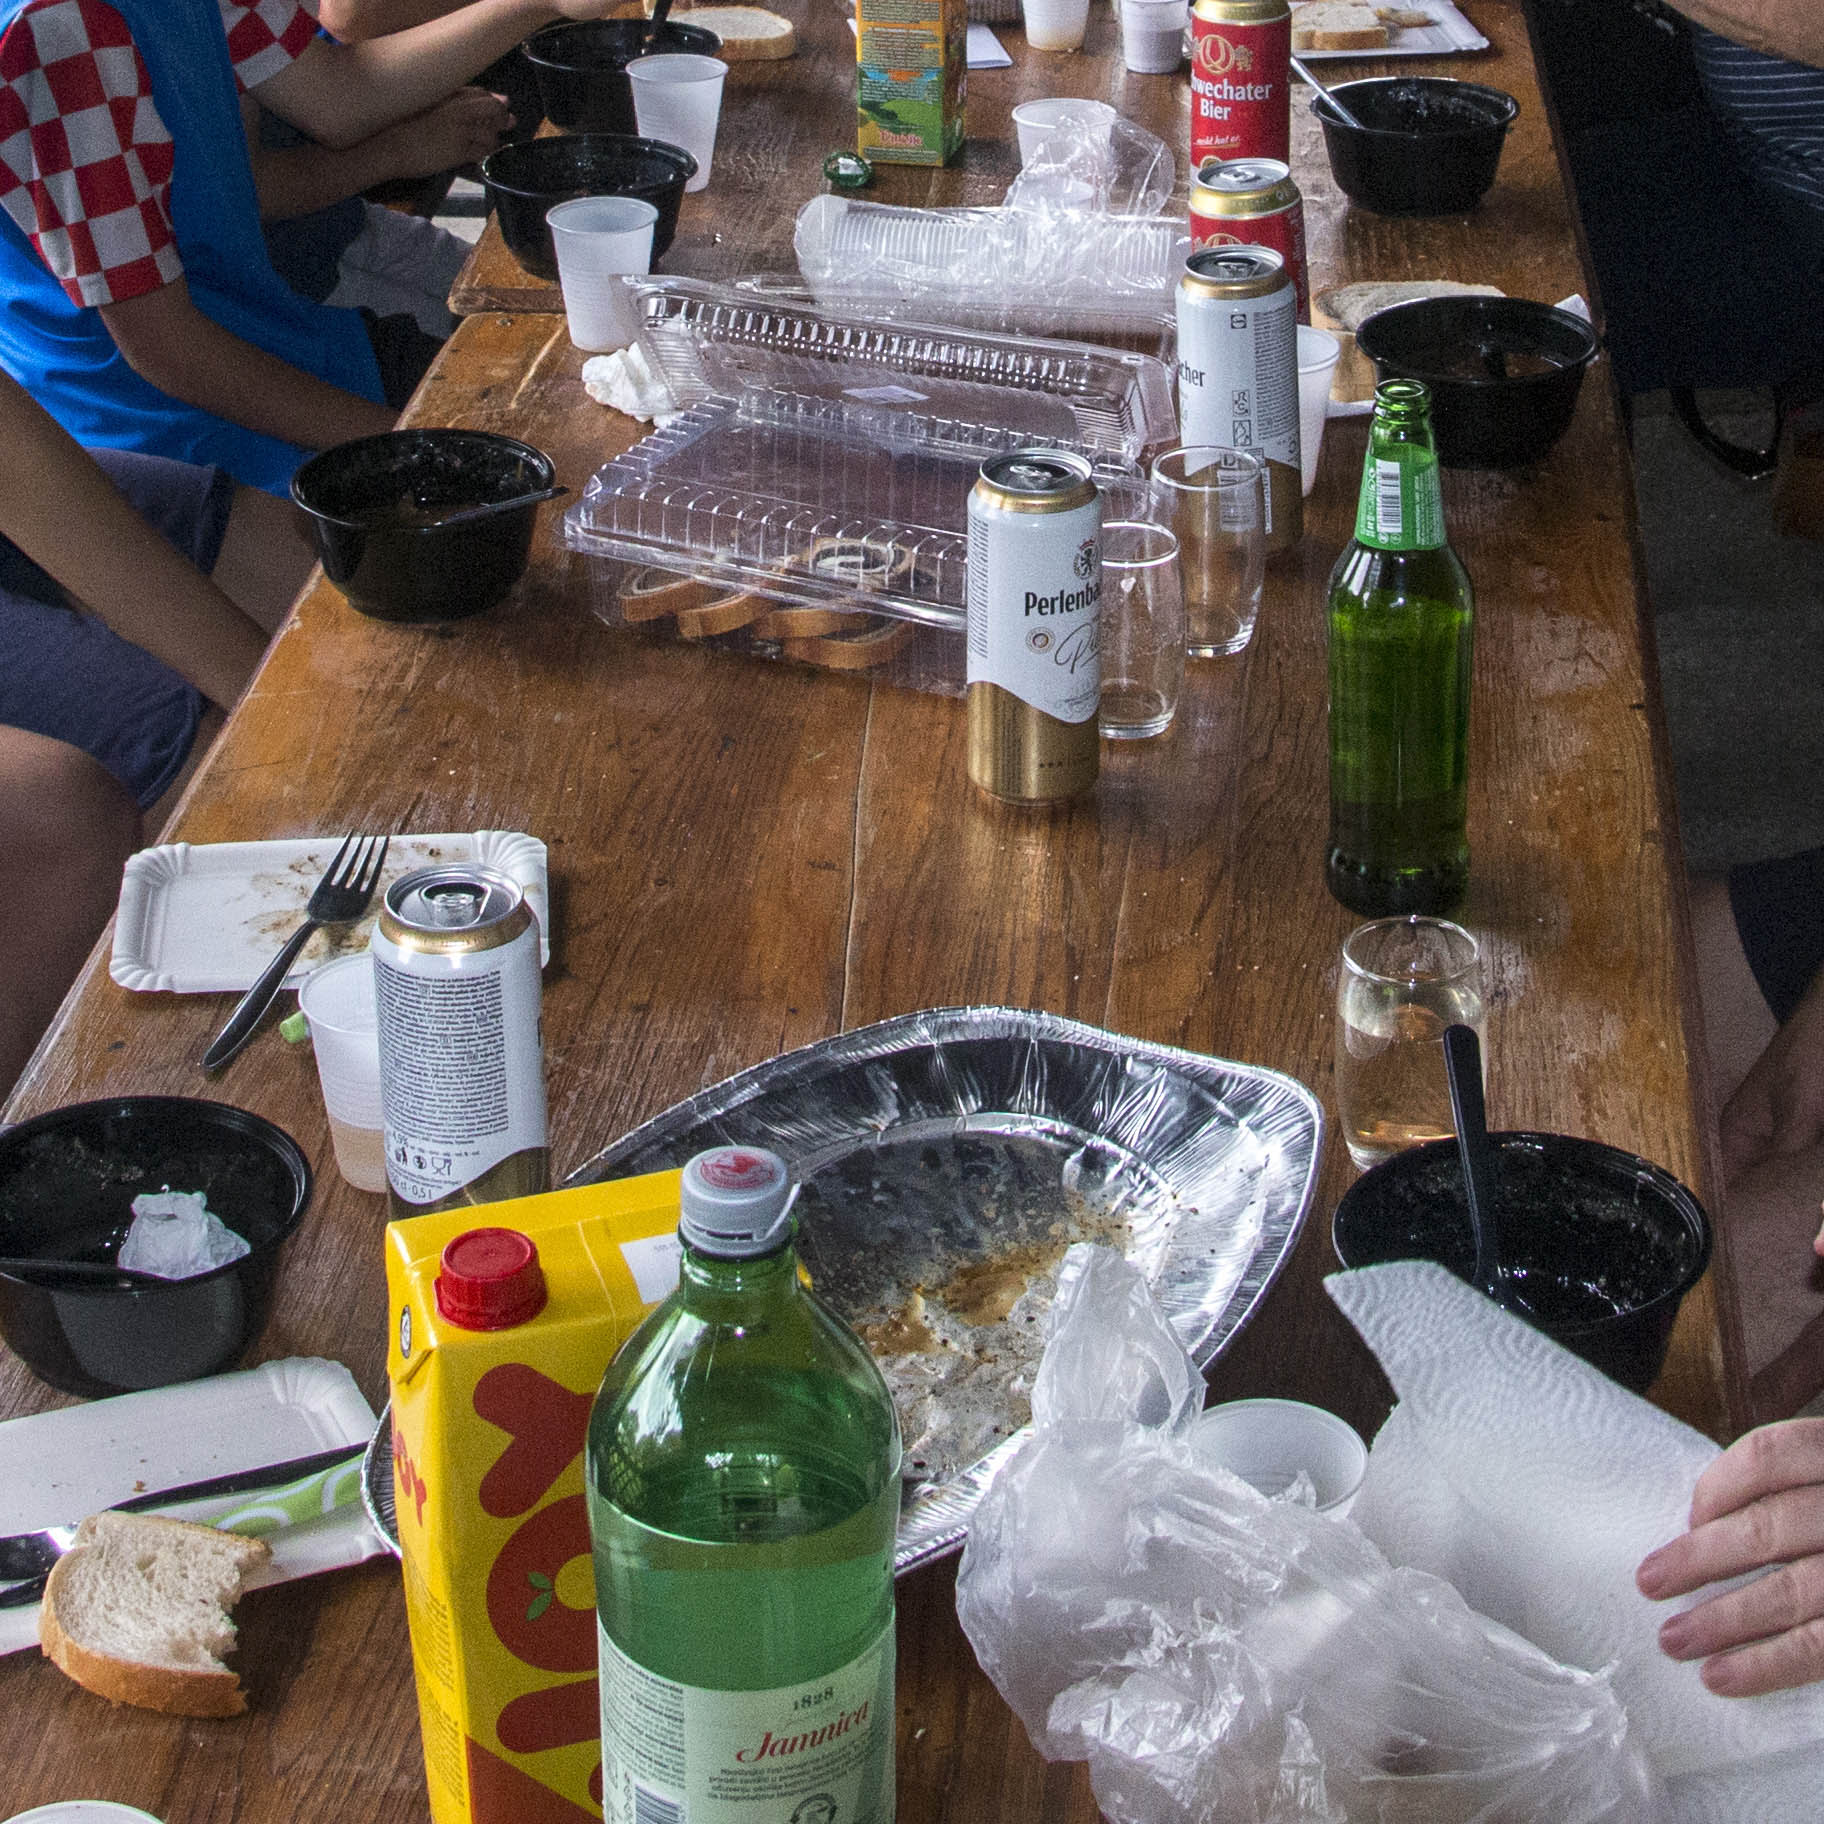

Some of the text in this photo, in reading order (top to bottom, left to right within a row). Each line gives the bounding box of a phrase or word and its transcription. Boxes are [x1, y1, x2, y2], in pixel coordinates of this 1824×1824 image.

[1200, 98, 1231, 120] Bier
[793, 1686, 834, 1712] 1828
[735, 1699, 870, 1764] Jamnica
